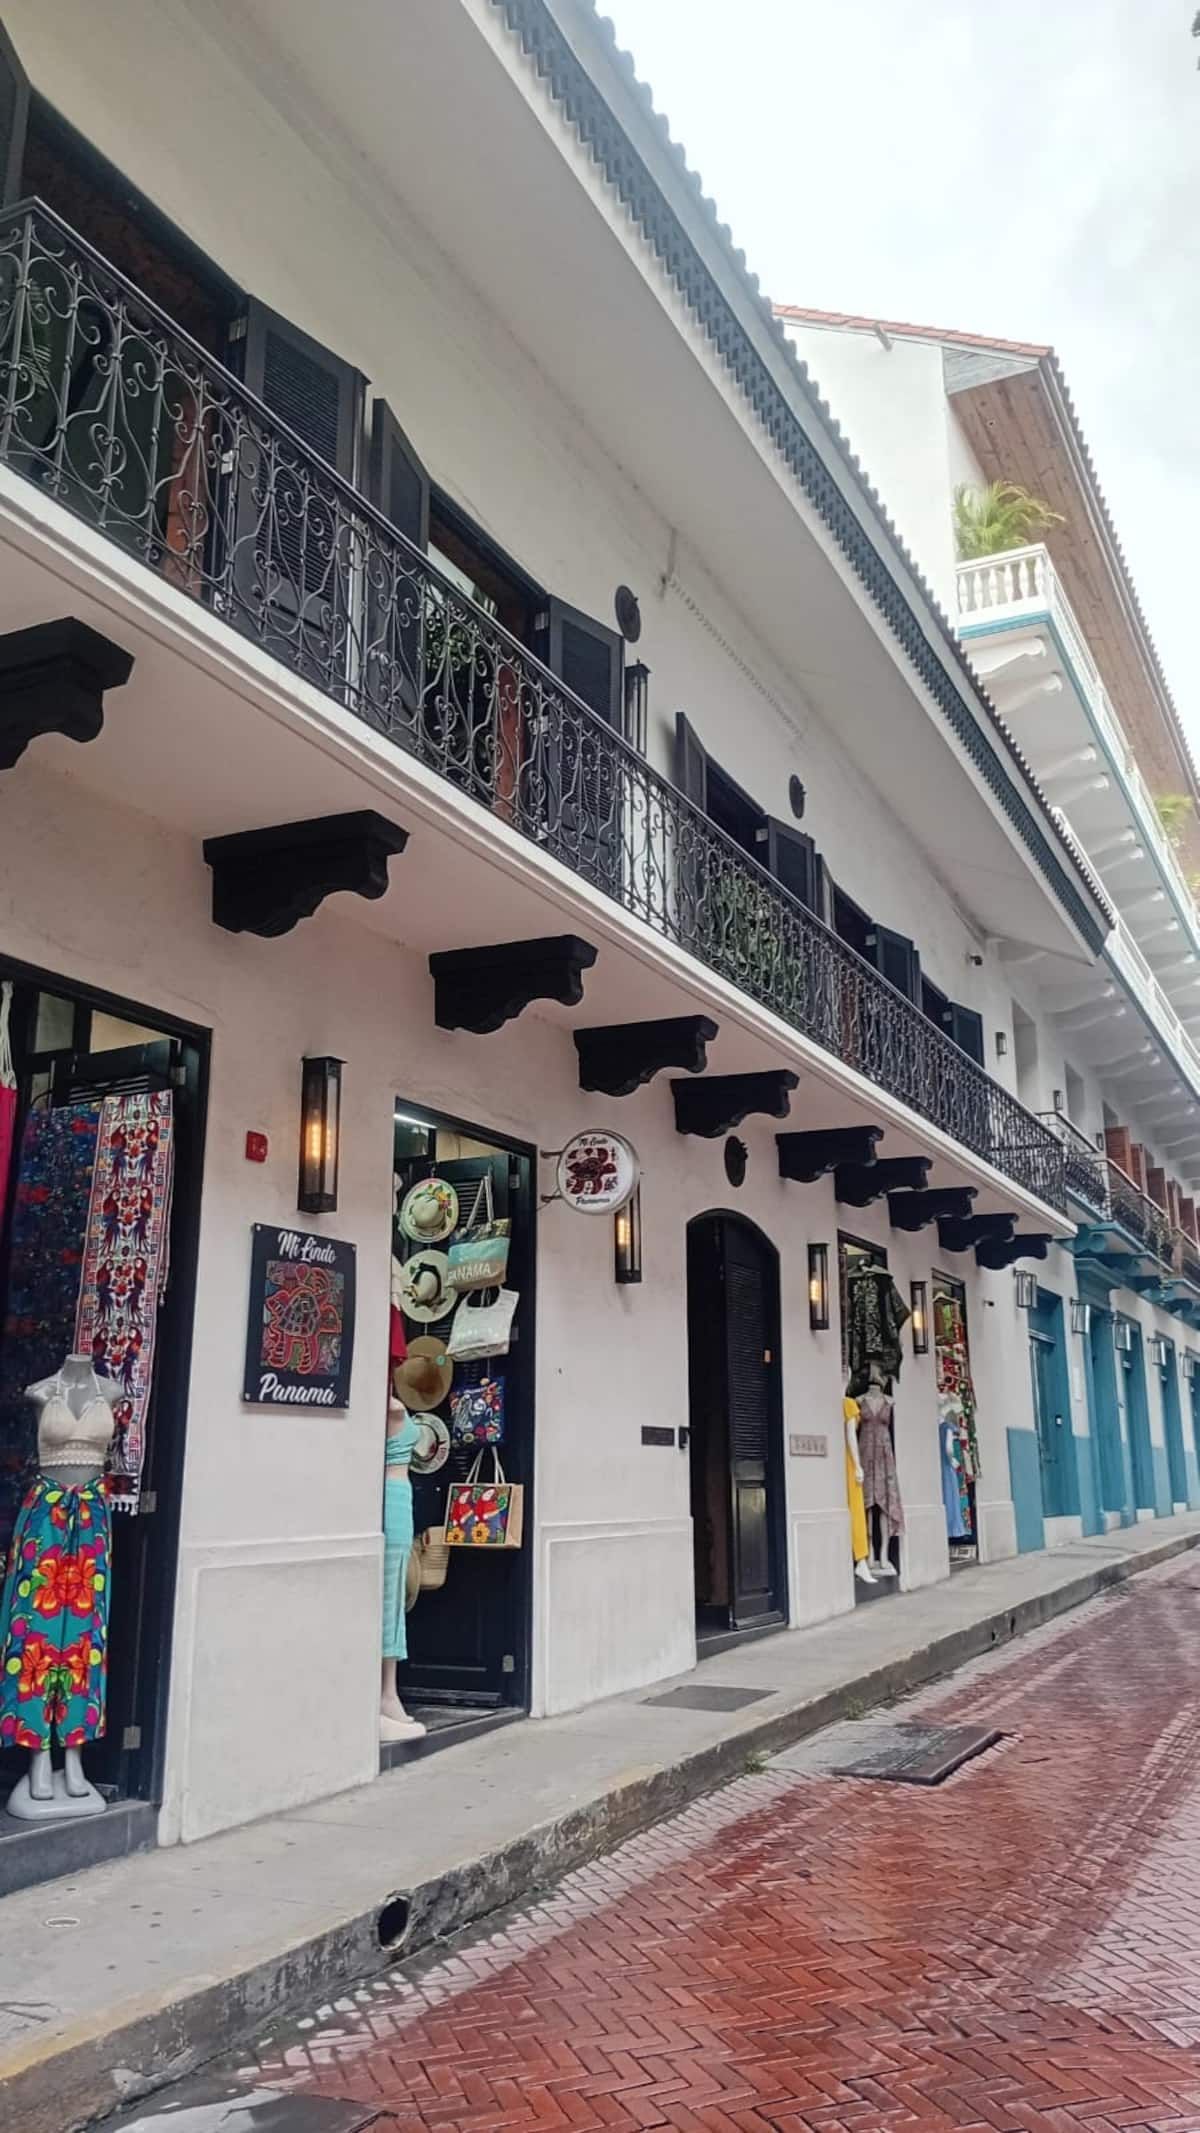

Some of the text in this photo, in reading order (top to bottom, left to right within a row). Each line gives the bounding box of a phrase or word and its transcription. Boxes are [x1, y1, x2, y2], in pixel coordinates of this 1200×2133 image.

[278, 1231, 336, 1264] Mi Lindo
[259, 1372, 336, 1405] Panamá
